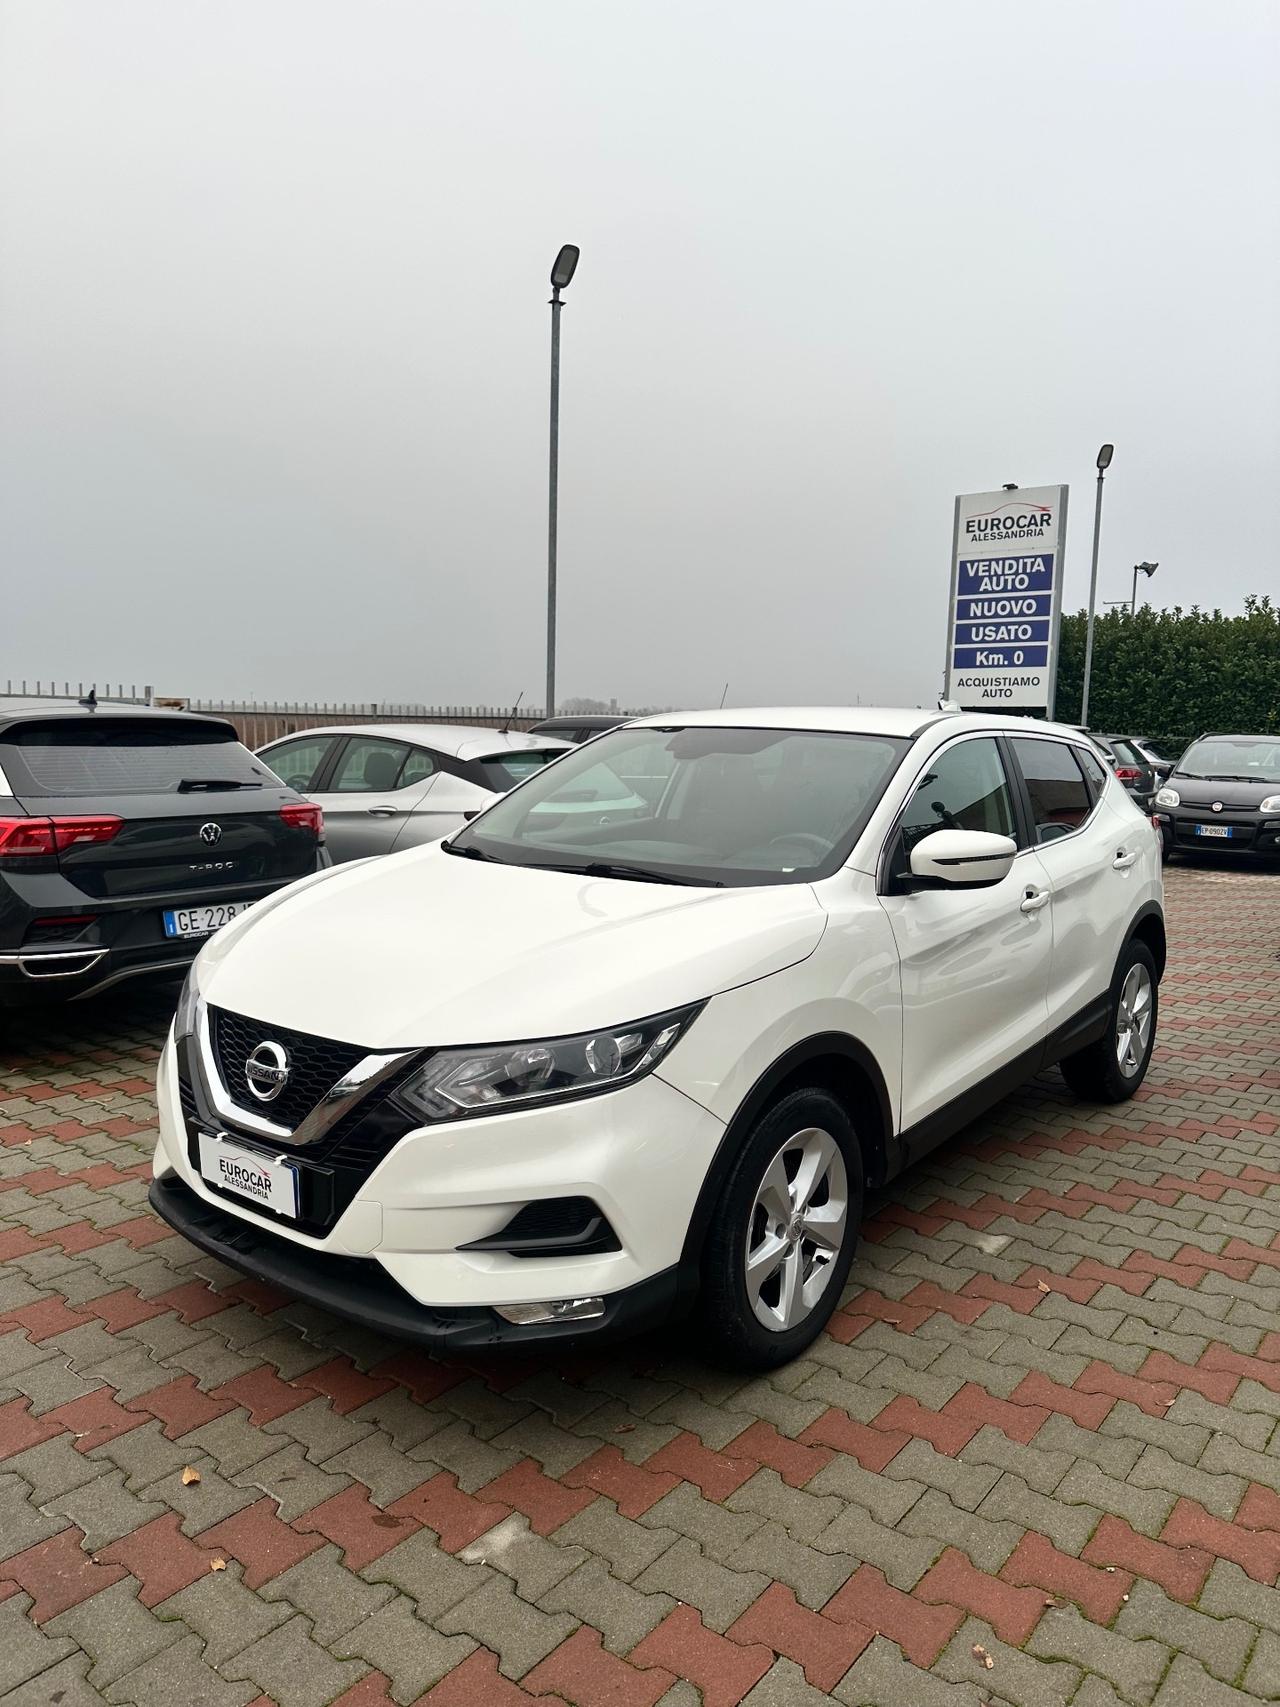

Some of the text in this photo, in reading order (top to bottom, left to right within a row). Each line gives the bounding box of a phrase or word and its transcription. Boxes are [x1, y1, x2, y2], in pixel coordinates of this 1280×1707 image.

[965, 513, 1052, 534] EUROCAR
[970, 528, 1044, 542] ALESSANDRIA
[966, 557, 1046, 577] VENDITA
[979, 574, 1029, 592] AUTO
[969, 599, 1037, 617] NUOVO
[971, 624, 1032, 642] USATO
[975, 650, 1024, 666] Km. 0
[957, 676, 1040, 687] ACQUISTIAMO
[981, 688, 1013, 698] AUTO
[219, 1158, 272, 1193] EUROCAR
[224, 1174, 269, 1200] ALESSANDRIA
